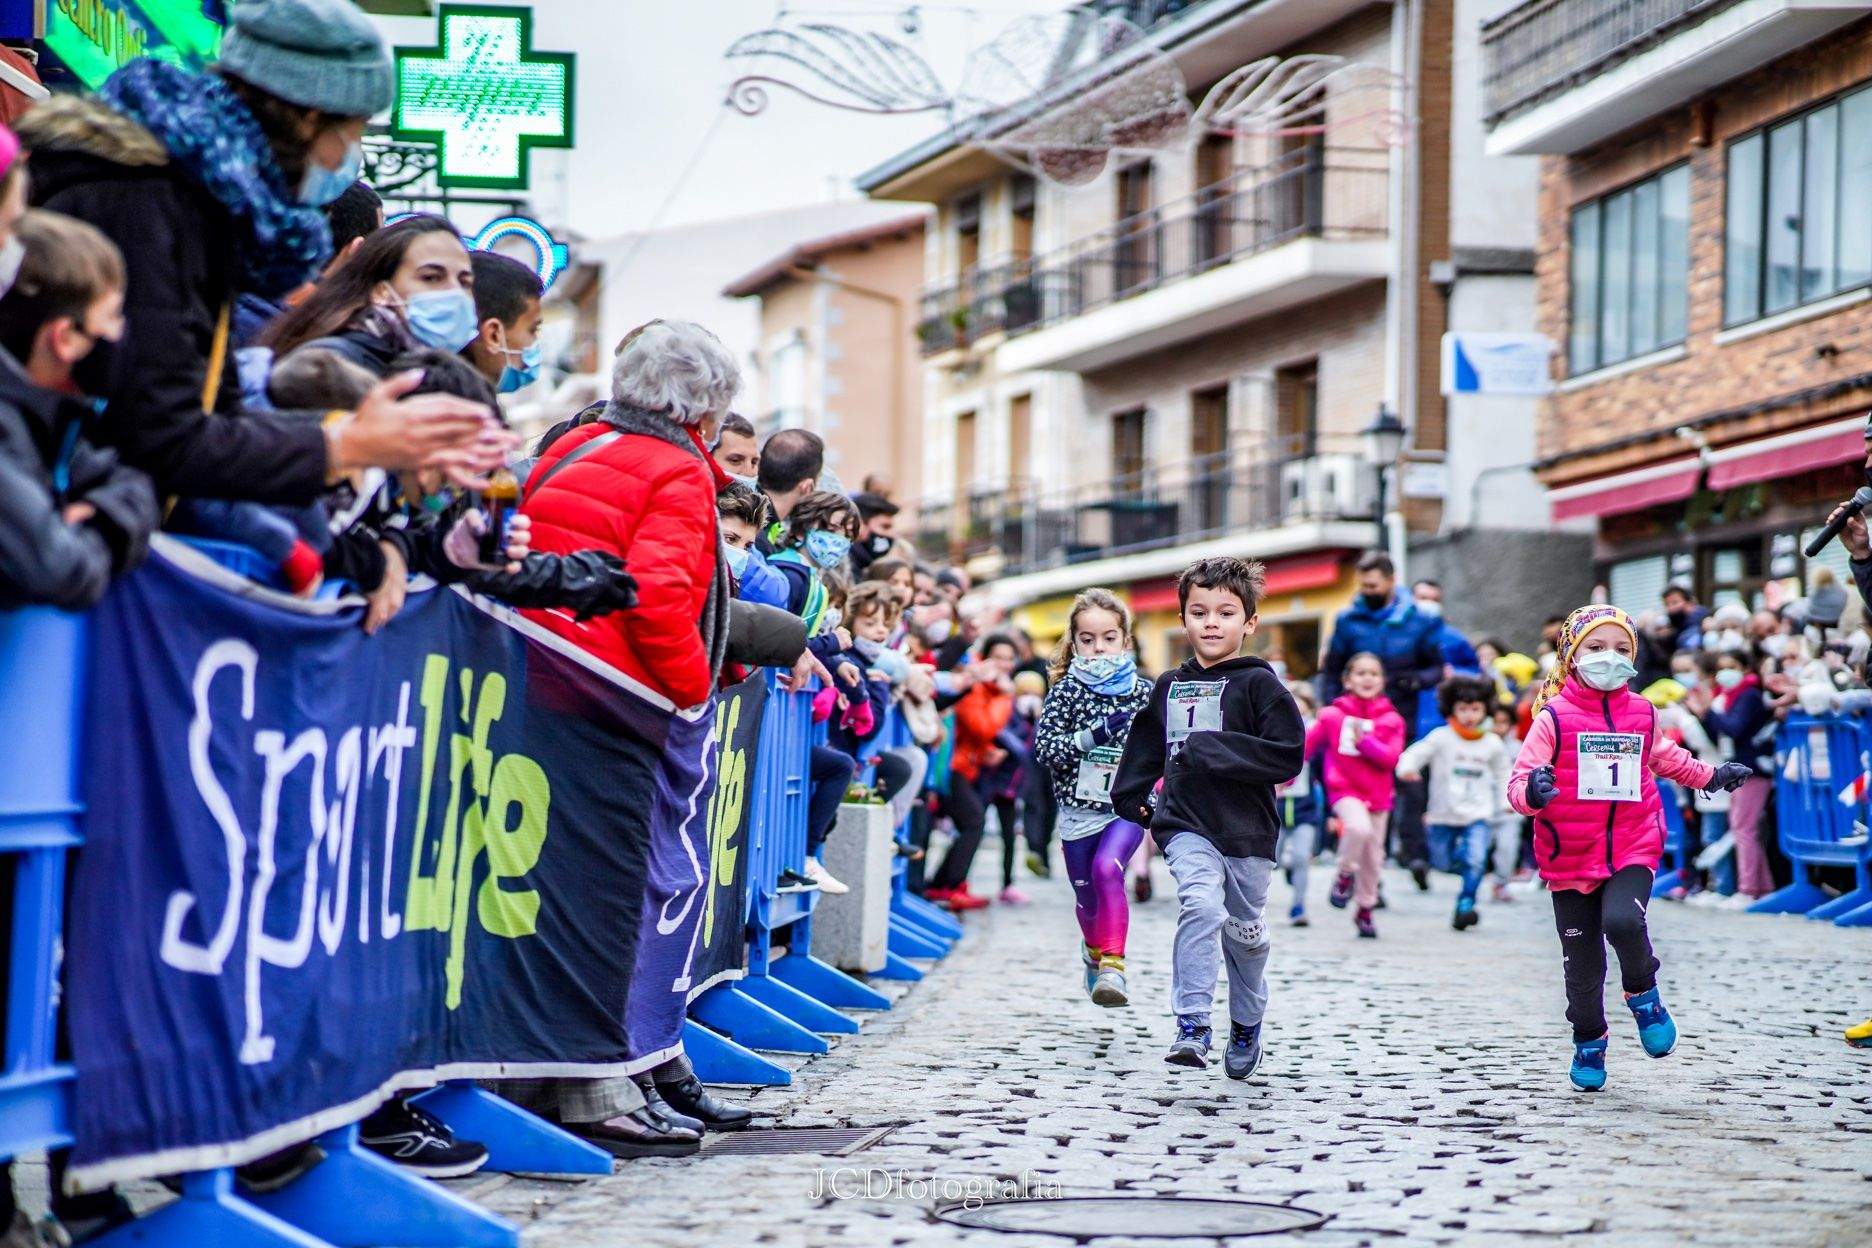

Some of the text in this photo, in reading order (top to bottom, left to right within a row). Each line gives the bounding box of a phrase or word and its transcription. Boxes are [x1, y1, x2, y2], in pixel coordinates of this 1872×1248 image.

[1187, 705, 1195, 728] 1
[1103, 772, 1111, 791] 1
[1608, 763, 1618, 786] 1
